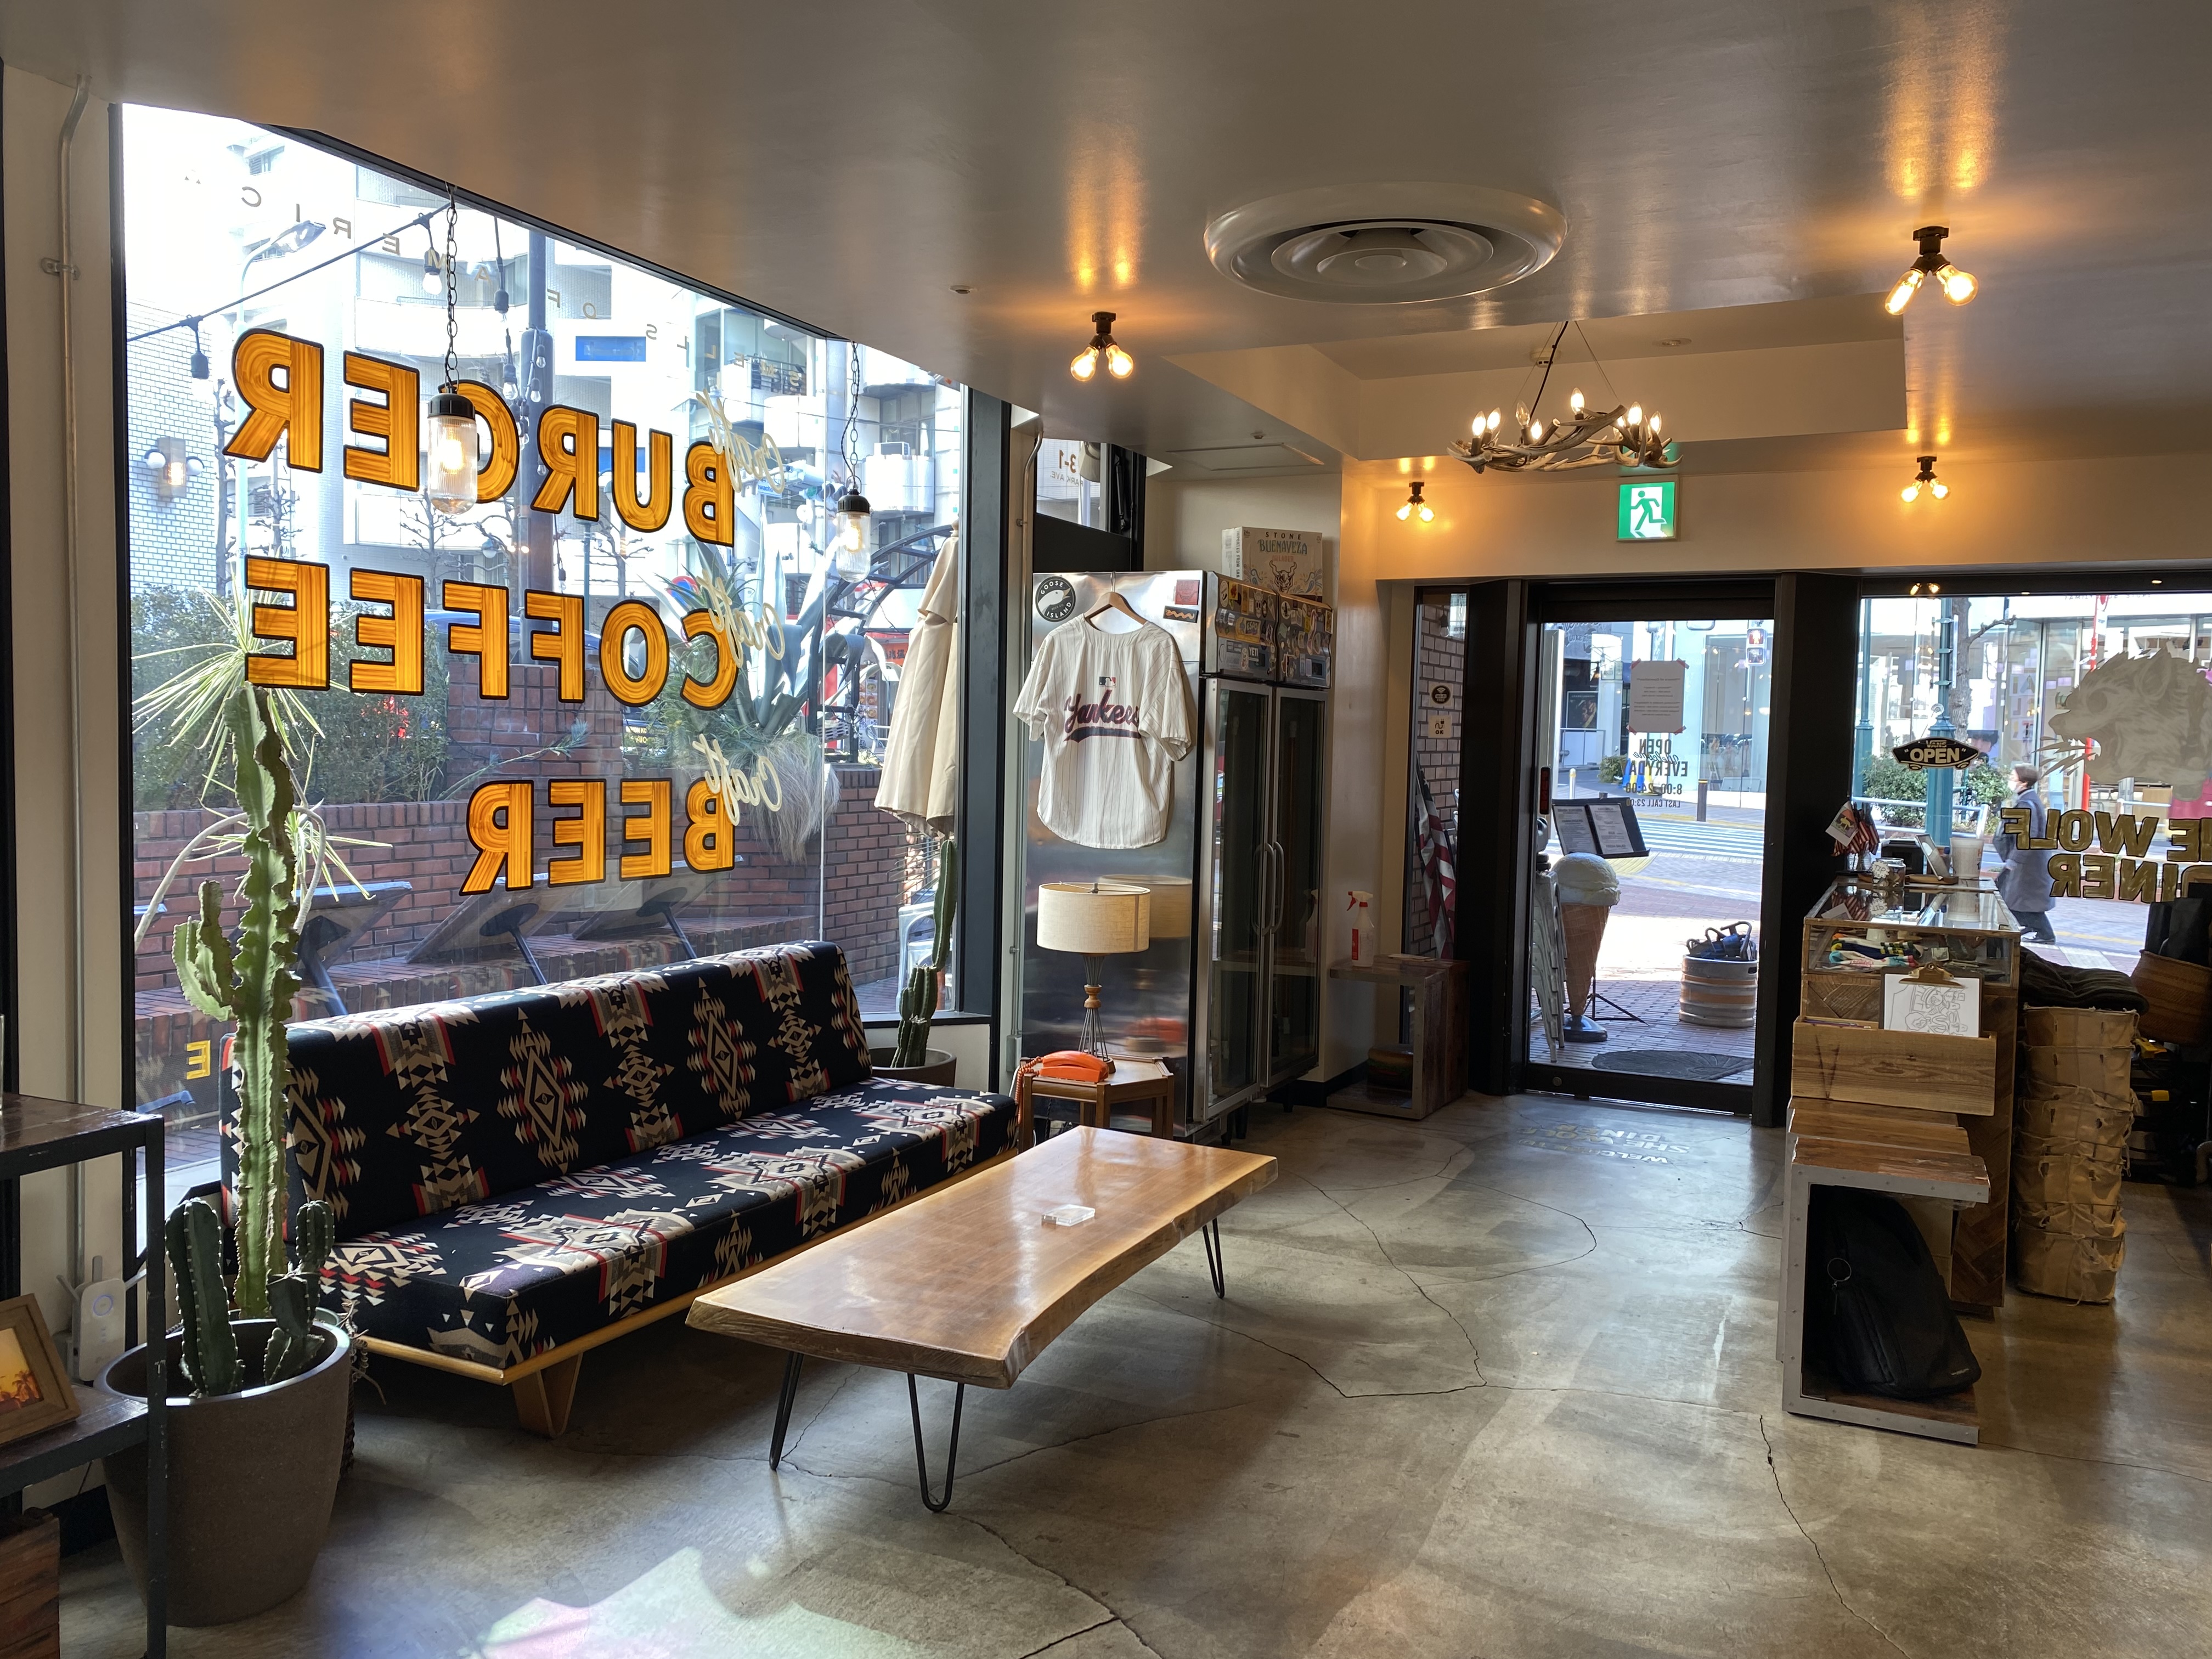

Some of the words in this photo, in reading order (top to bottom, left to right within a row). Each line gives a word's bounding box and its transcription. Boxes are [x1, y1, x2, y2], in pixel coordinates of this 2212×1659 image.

[1265, 531, 1302, 540] STONE
[1257, 539, 1308, 555] BUENAVEZA
[1040, 580, 1064, 595] GOOSE
[1046, 602, 1071, 618] ISLAND
[1249, 646, 1259, 657] YETI
[1064, 689, 1139, 733] Yankees
[1926, 740, 1947, 748] VANS
[1875, 864, 1886, 873] TIP
[1622, 1139, 1691, 1154] SHE
